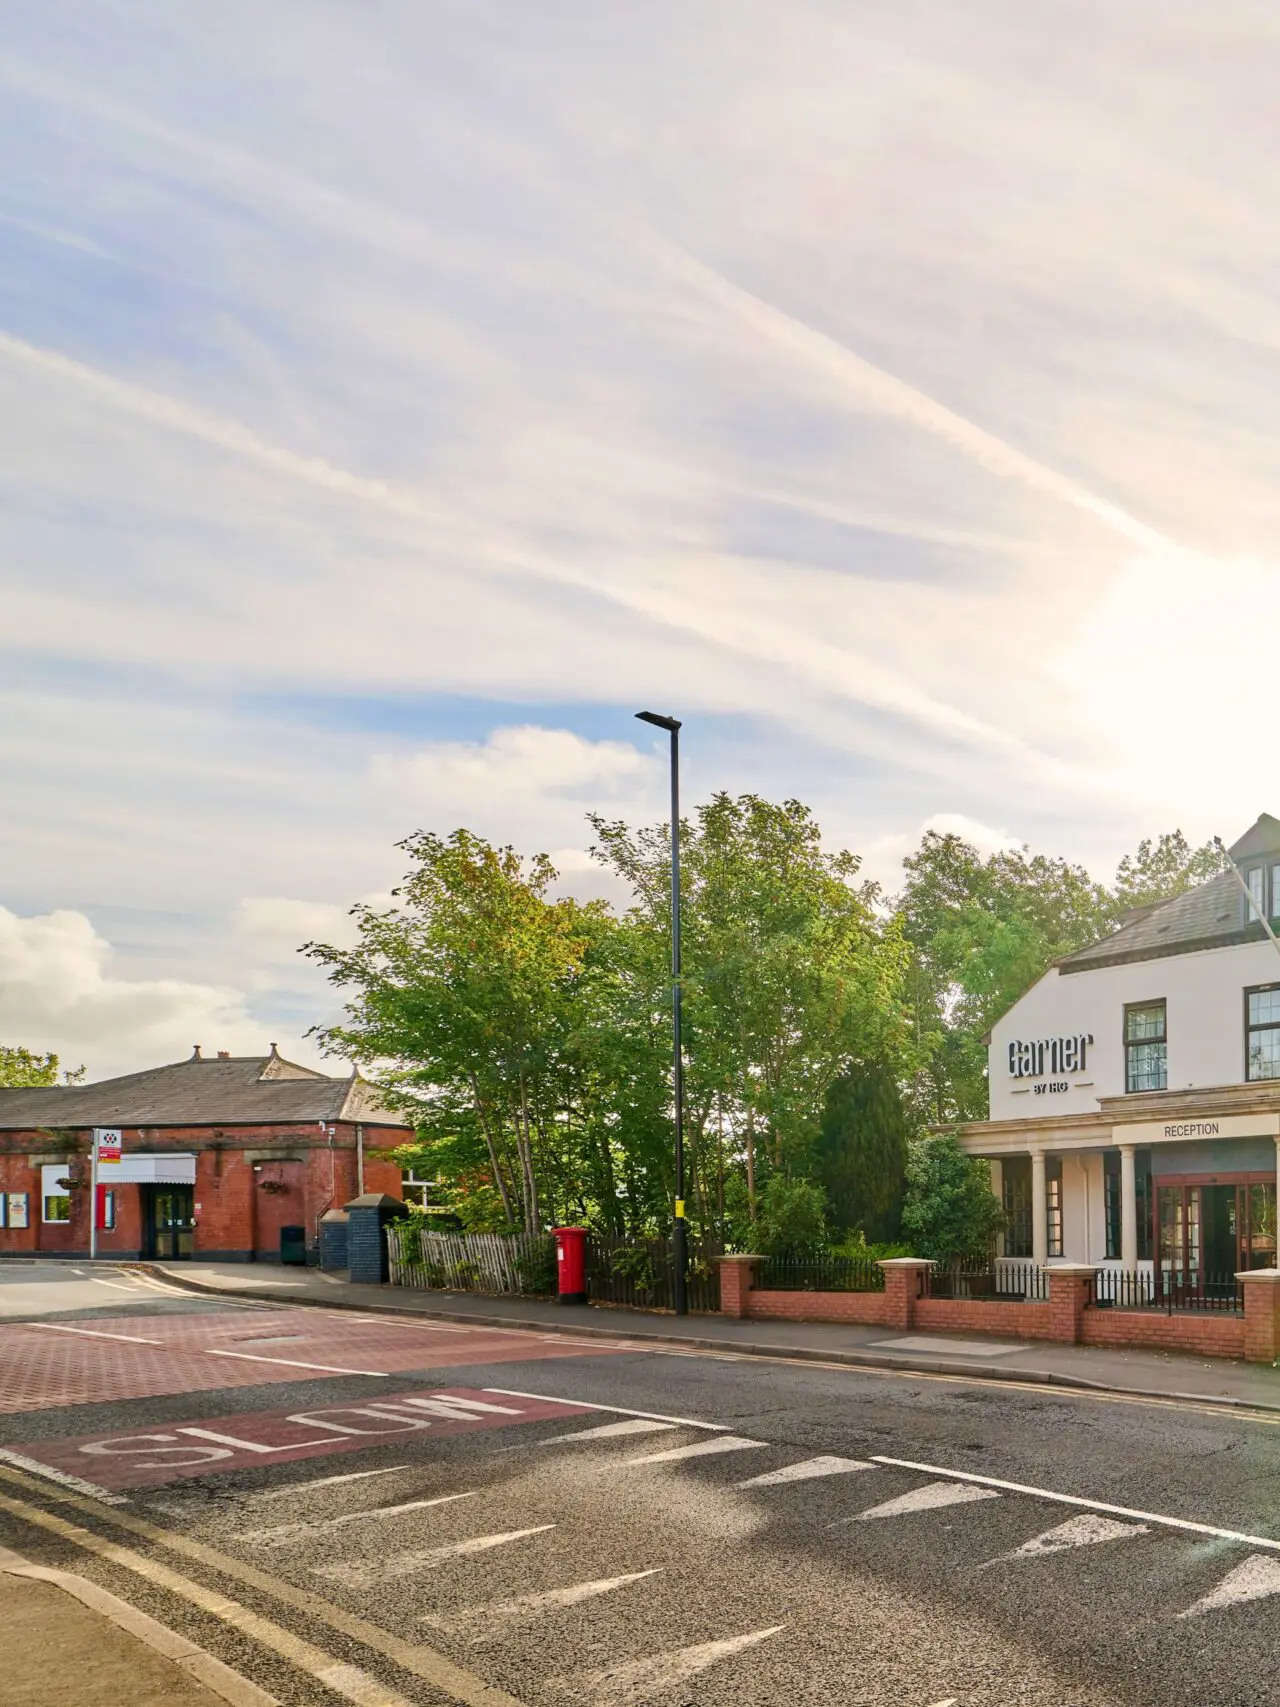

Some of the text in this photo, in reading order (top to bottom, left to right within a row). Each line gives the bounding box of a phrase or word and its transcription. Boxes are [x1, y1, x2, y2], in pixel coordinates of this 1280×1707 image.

[1008, 1033, 1093, 1078] Garner
[1033, 1081, 1069, 1095] BY IHG
[1164, 1123, 1219, 1138] RECEPTION
[79, 1394, 525, 1468] SLOW
